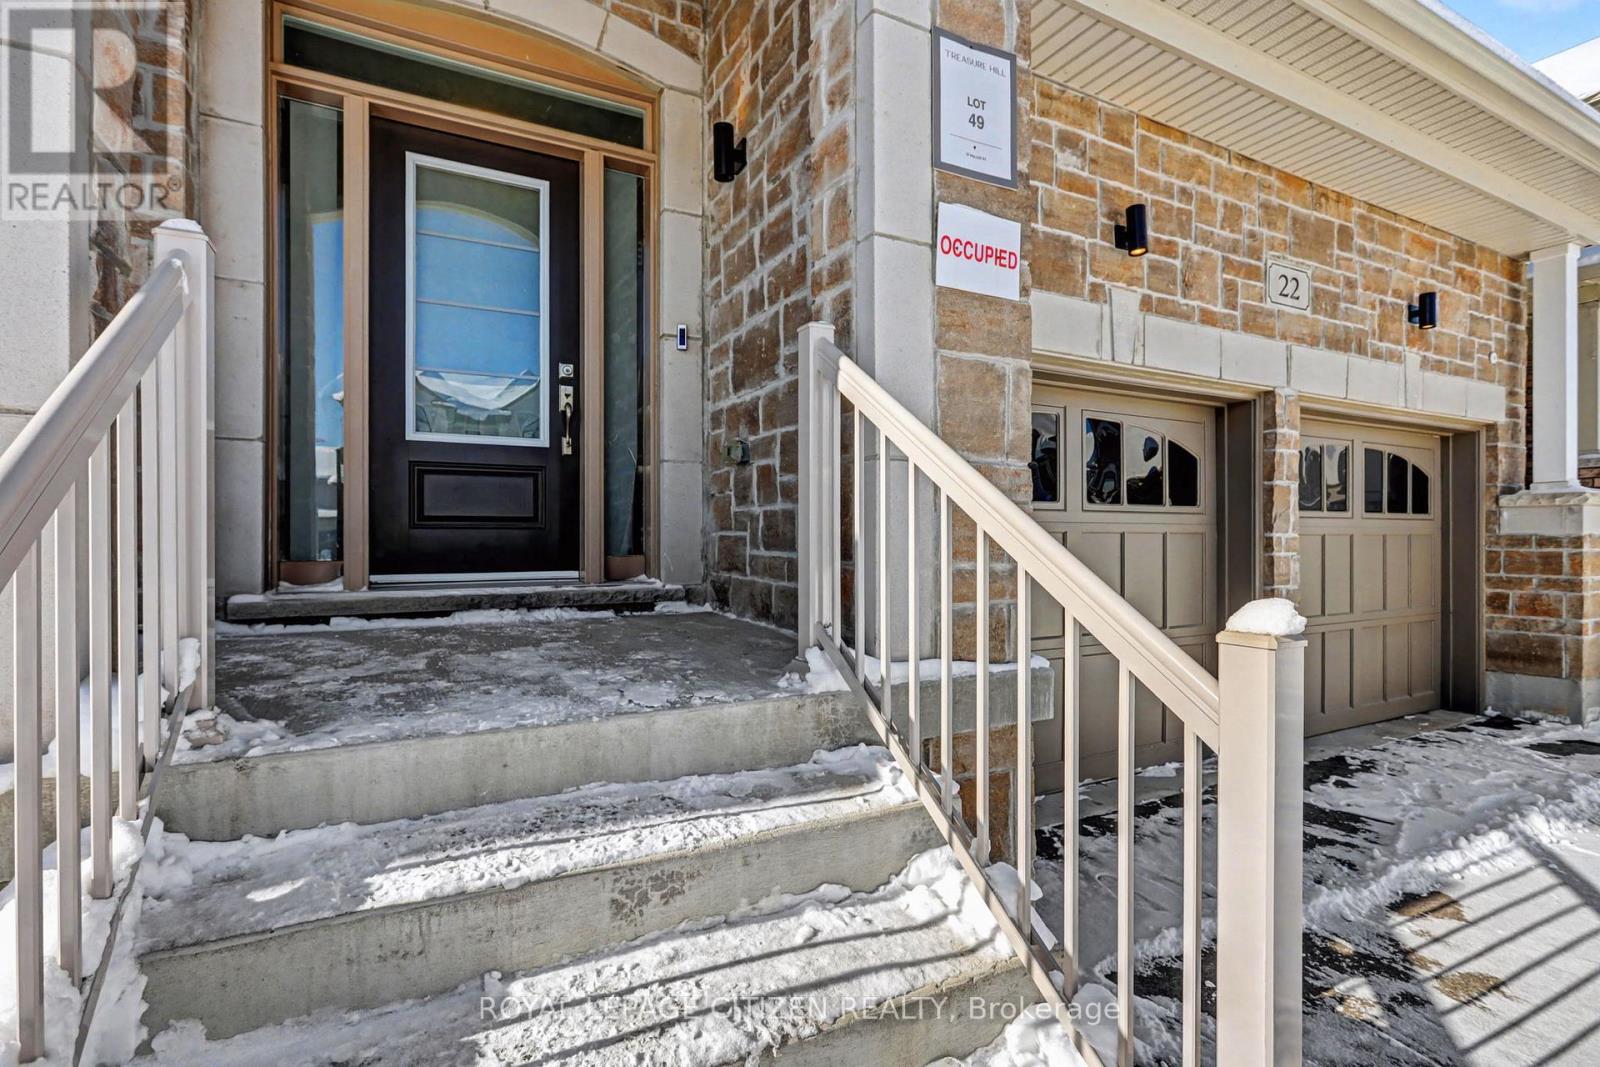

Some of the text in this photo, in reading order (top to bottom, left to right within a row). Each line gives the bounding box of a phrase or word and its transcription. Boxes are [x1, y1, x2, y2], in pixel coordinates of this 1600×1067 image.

[945, 49, 1006, 77] TREASURE HILL
[967, 96, 986, 110] LOT
[968, 113, 985, 129] 49
[940, 235, 1018, 270] OCCUPIED
[1279, 274, 1300, 300] 22
